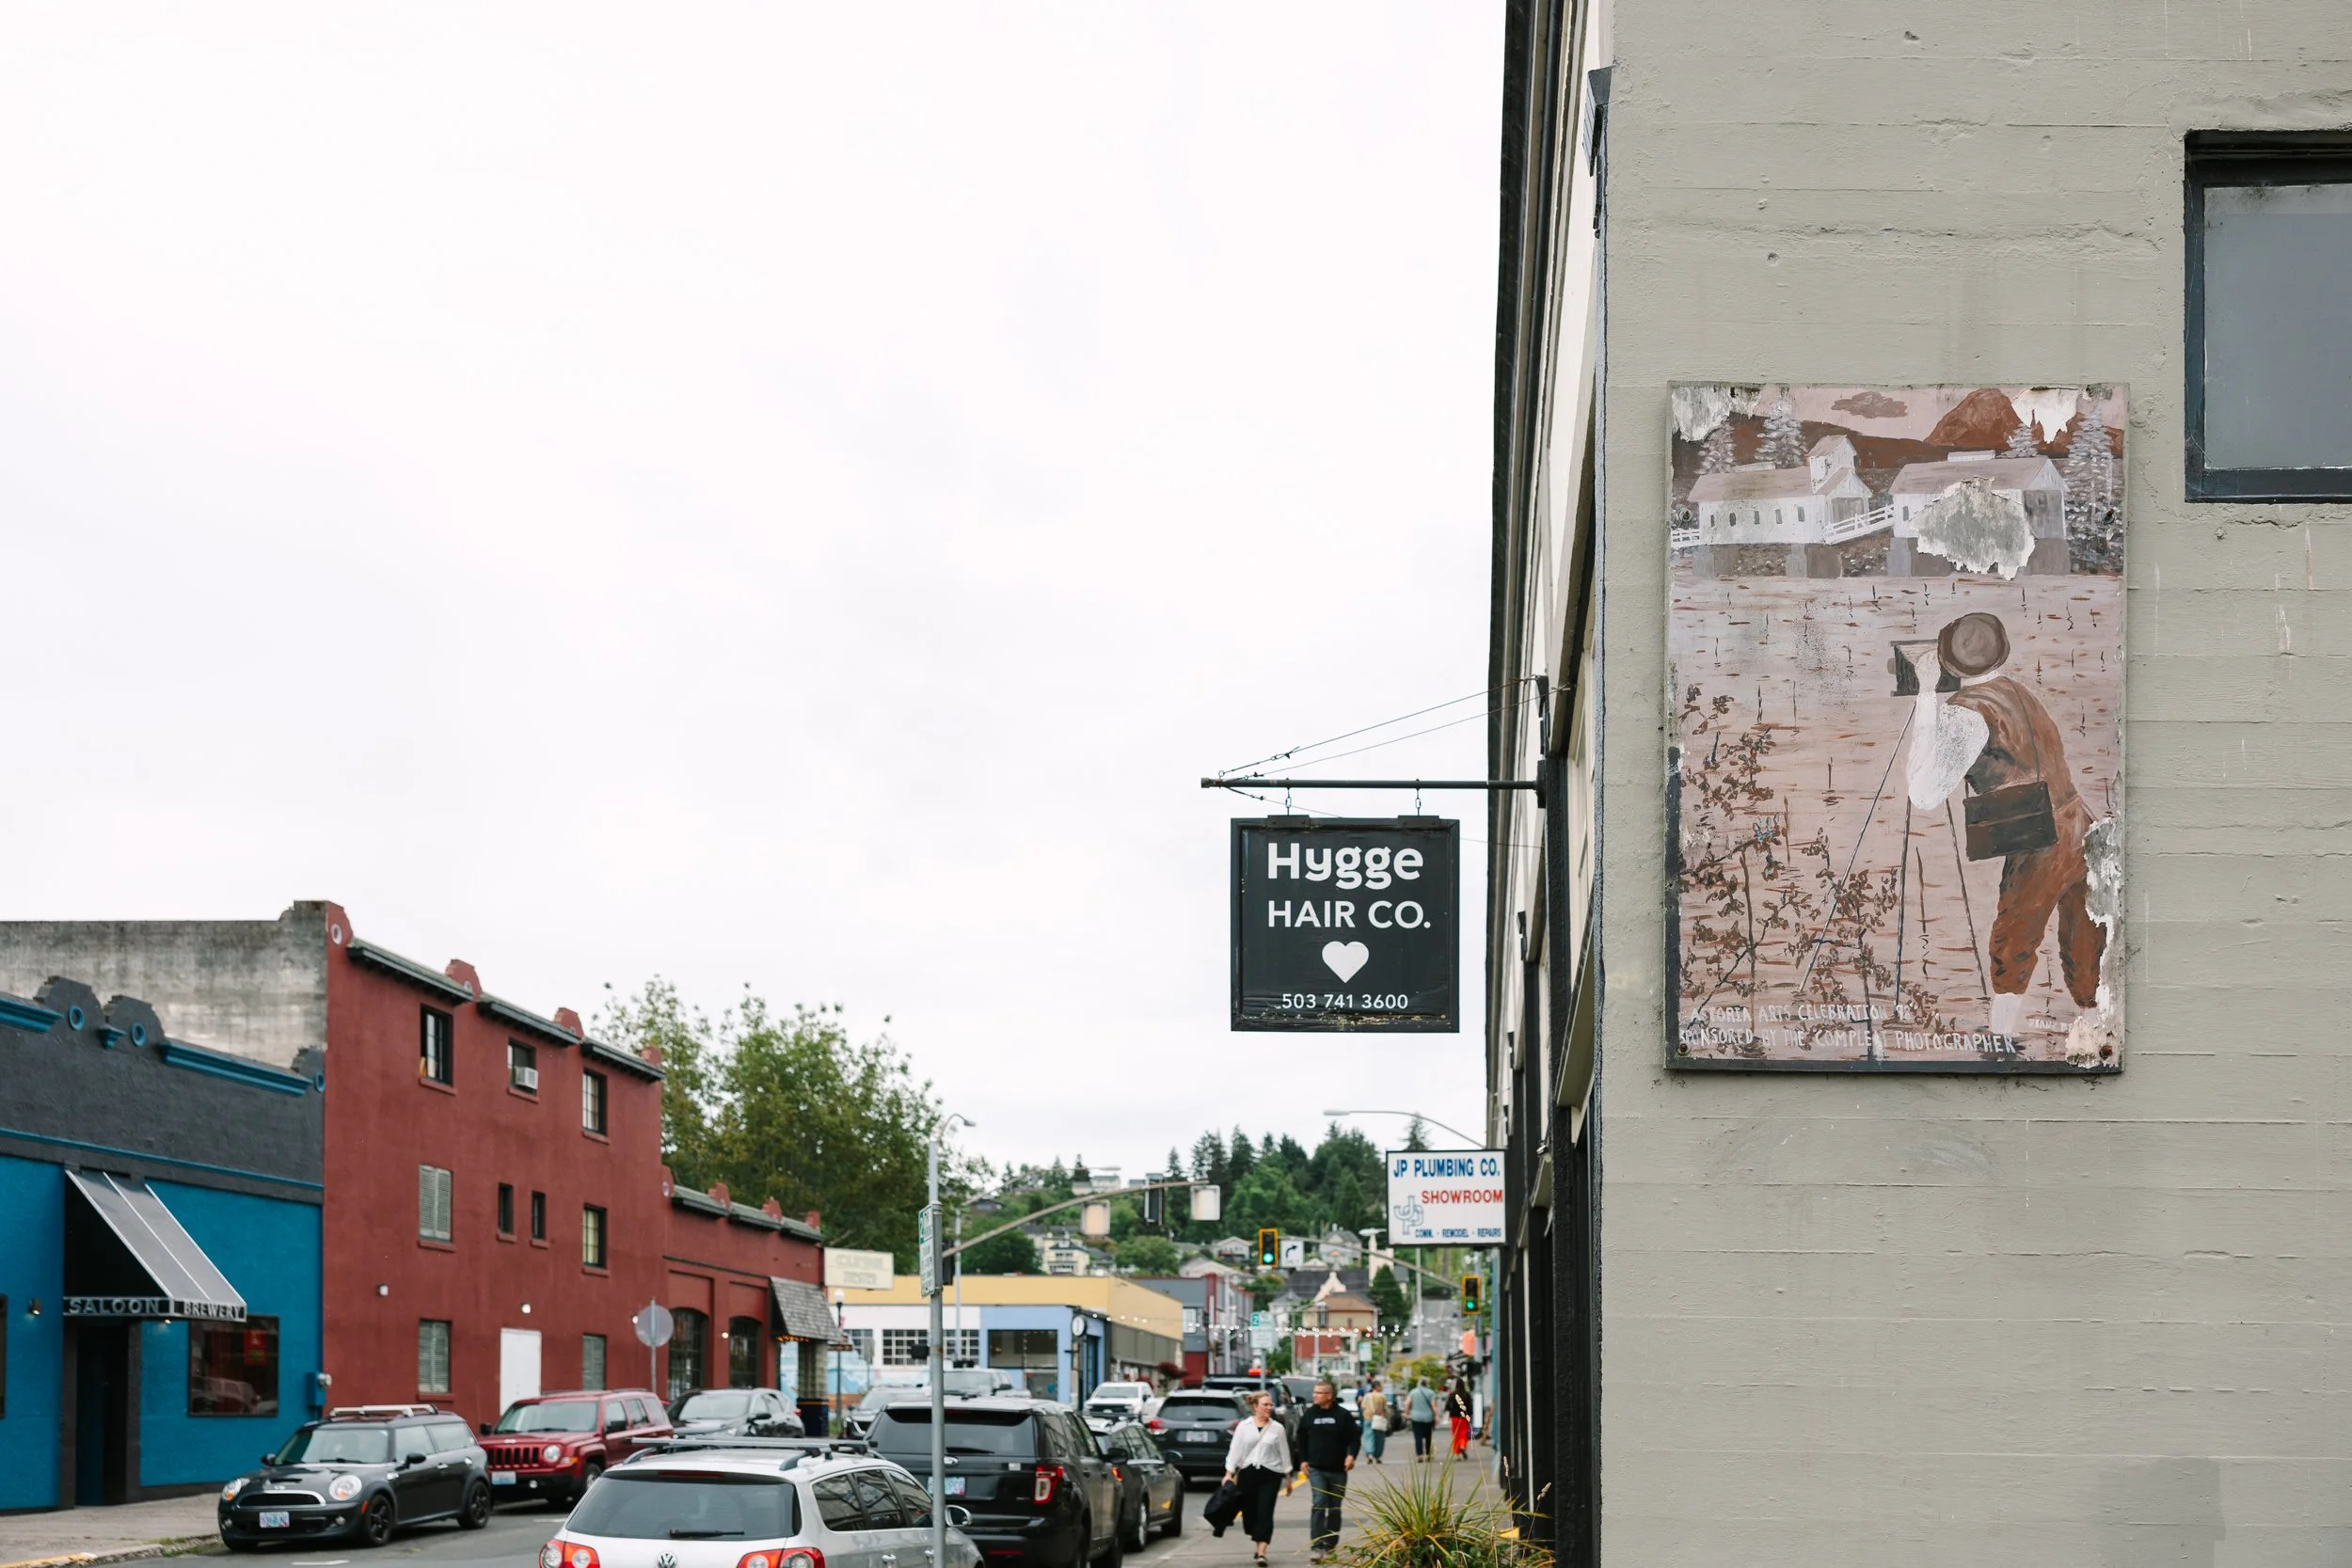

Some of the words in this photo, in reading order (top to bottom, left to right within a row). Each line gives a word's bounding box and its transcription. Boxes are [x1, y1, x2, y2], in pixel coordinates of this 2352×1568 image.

[1267, 842, 1423, 890] Hygge
[1267, 900, 1356, 927] HAIR
[1368, 900, 1431, 928] CO.
[1281, 993, 1316, 1009] 503
[1324, 994, 1353, 1008] 741
[1361, 994, 1408, 1009] 3600
[1691, 1006, 1752, 1023] ASTORIA
[1758, 1005, 1791, 1022] ARTS
[1798, 1003, 1888, 1022] CELEBRATION
[1679, 1026, 1754, 1046] SPONSORED
[1762, 1029, 1776, 1047] BY
[1782, 1030, 1805, 1047] THE
[1392, 1159, 1407, 1178] JP
[1414, 1158, 1474, 1178] PLUMBING
[1480, 1157, 1501, 1177] CO.
[1422, 1190, 1503, 1204] SHOWROOM
[1477, 1227, 1502, 1238] REPAIRS
[69, 1297, 160, 1315] SALOON
[183, 1301, 241, 1319] BREWERY
